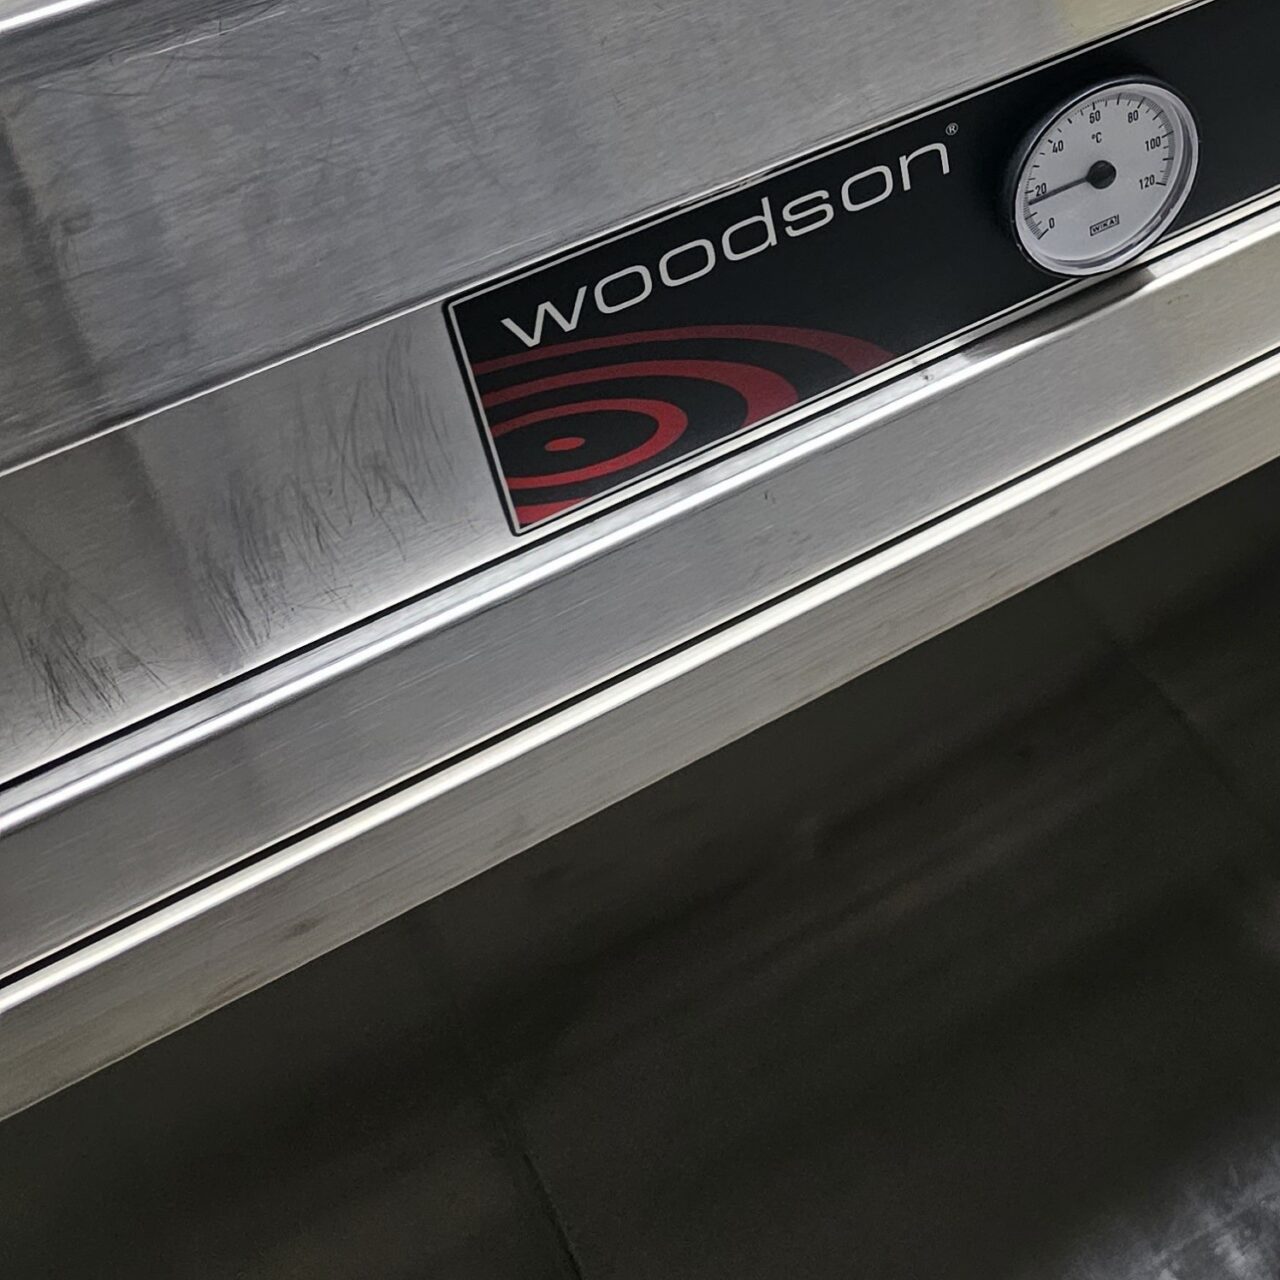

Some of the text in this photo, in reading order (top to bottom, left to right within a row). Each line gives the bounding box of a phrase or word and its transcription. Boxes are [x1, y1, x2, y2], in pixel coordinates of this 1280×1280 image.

[1089, 110, 1101, 124] 60
[1127, 109, 1139, 124] 80
[1052, 141, 1064, 154] 40
[1145, 135, 1162, 152] 100
[1035, 182, 1047, 197] 20
[1138, 174, 1155, 190] 120
[1048, 217, 1055, 229] 0
